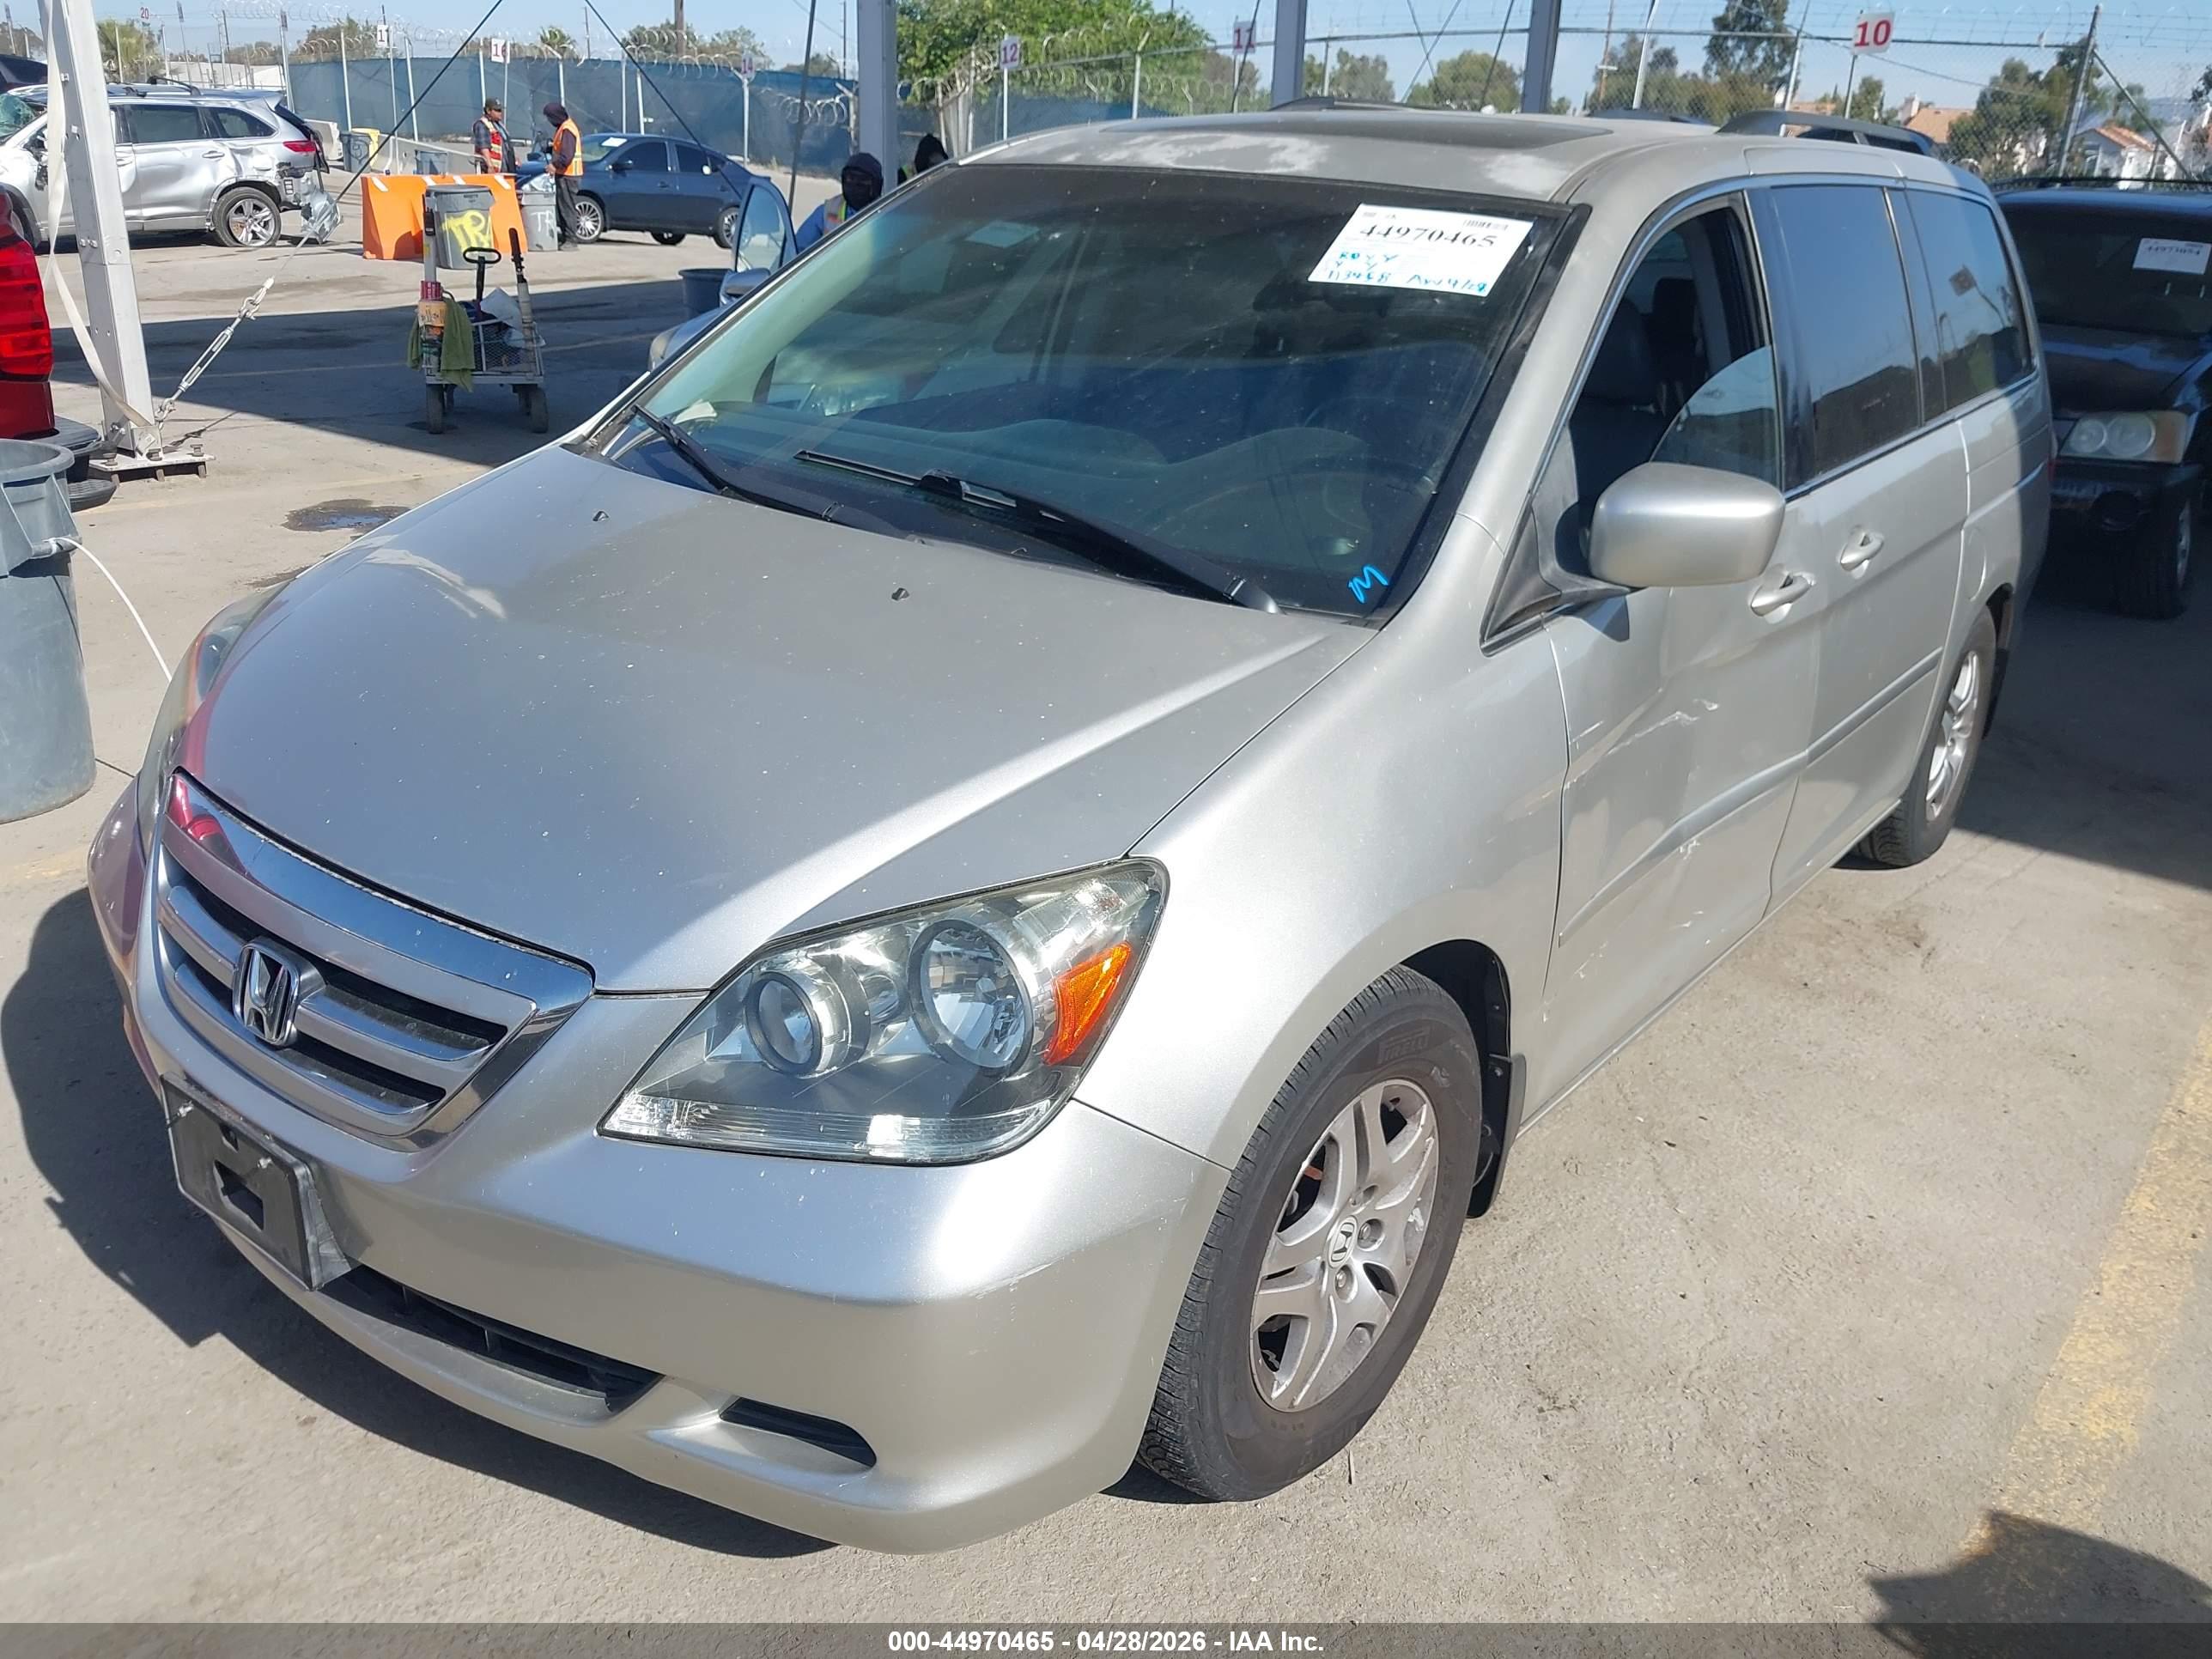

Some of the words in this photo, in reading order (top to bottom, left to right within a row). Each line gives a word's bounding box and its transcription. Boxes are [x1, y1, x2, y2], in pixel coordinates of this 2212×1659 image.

[140, 6, 149, 20] 20
[1854, 20, 1892, 47] 10
[1001, 43, 1018, 64] 12
[1360, 224, 1498, 247] 44970465
[1348, 566, 1389, 604] M
